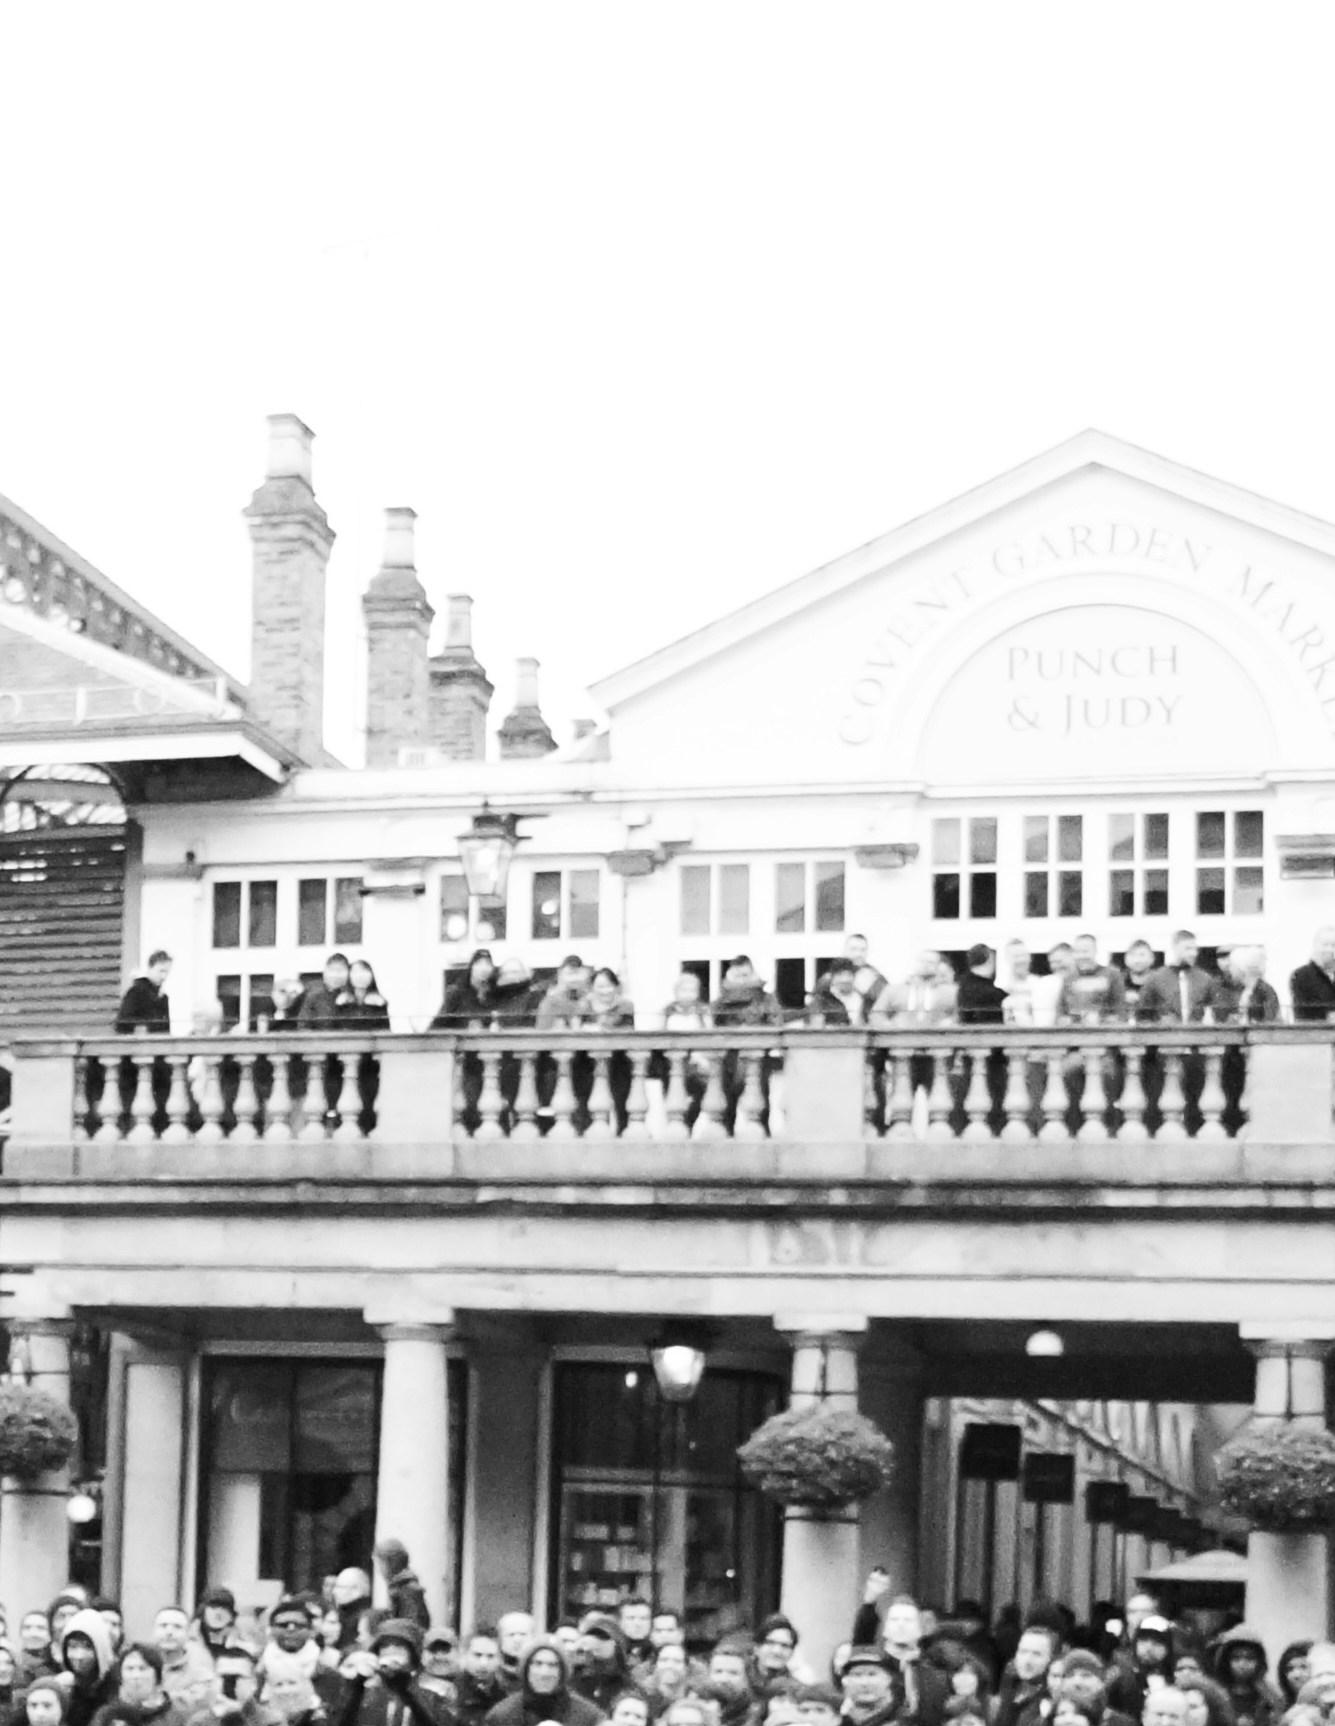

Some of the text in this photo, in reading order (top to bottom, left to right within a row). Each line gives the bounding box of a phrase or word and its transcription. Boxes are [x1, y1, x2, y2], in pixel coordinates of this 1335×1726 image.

[837, 560, 975, 747] COVENT
[991, 520, 1214, 577] GARDEN
[1007, 645, 1179, 682] PUNCH
[1007, 692, 1185, 740] & JUDY
